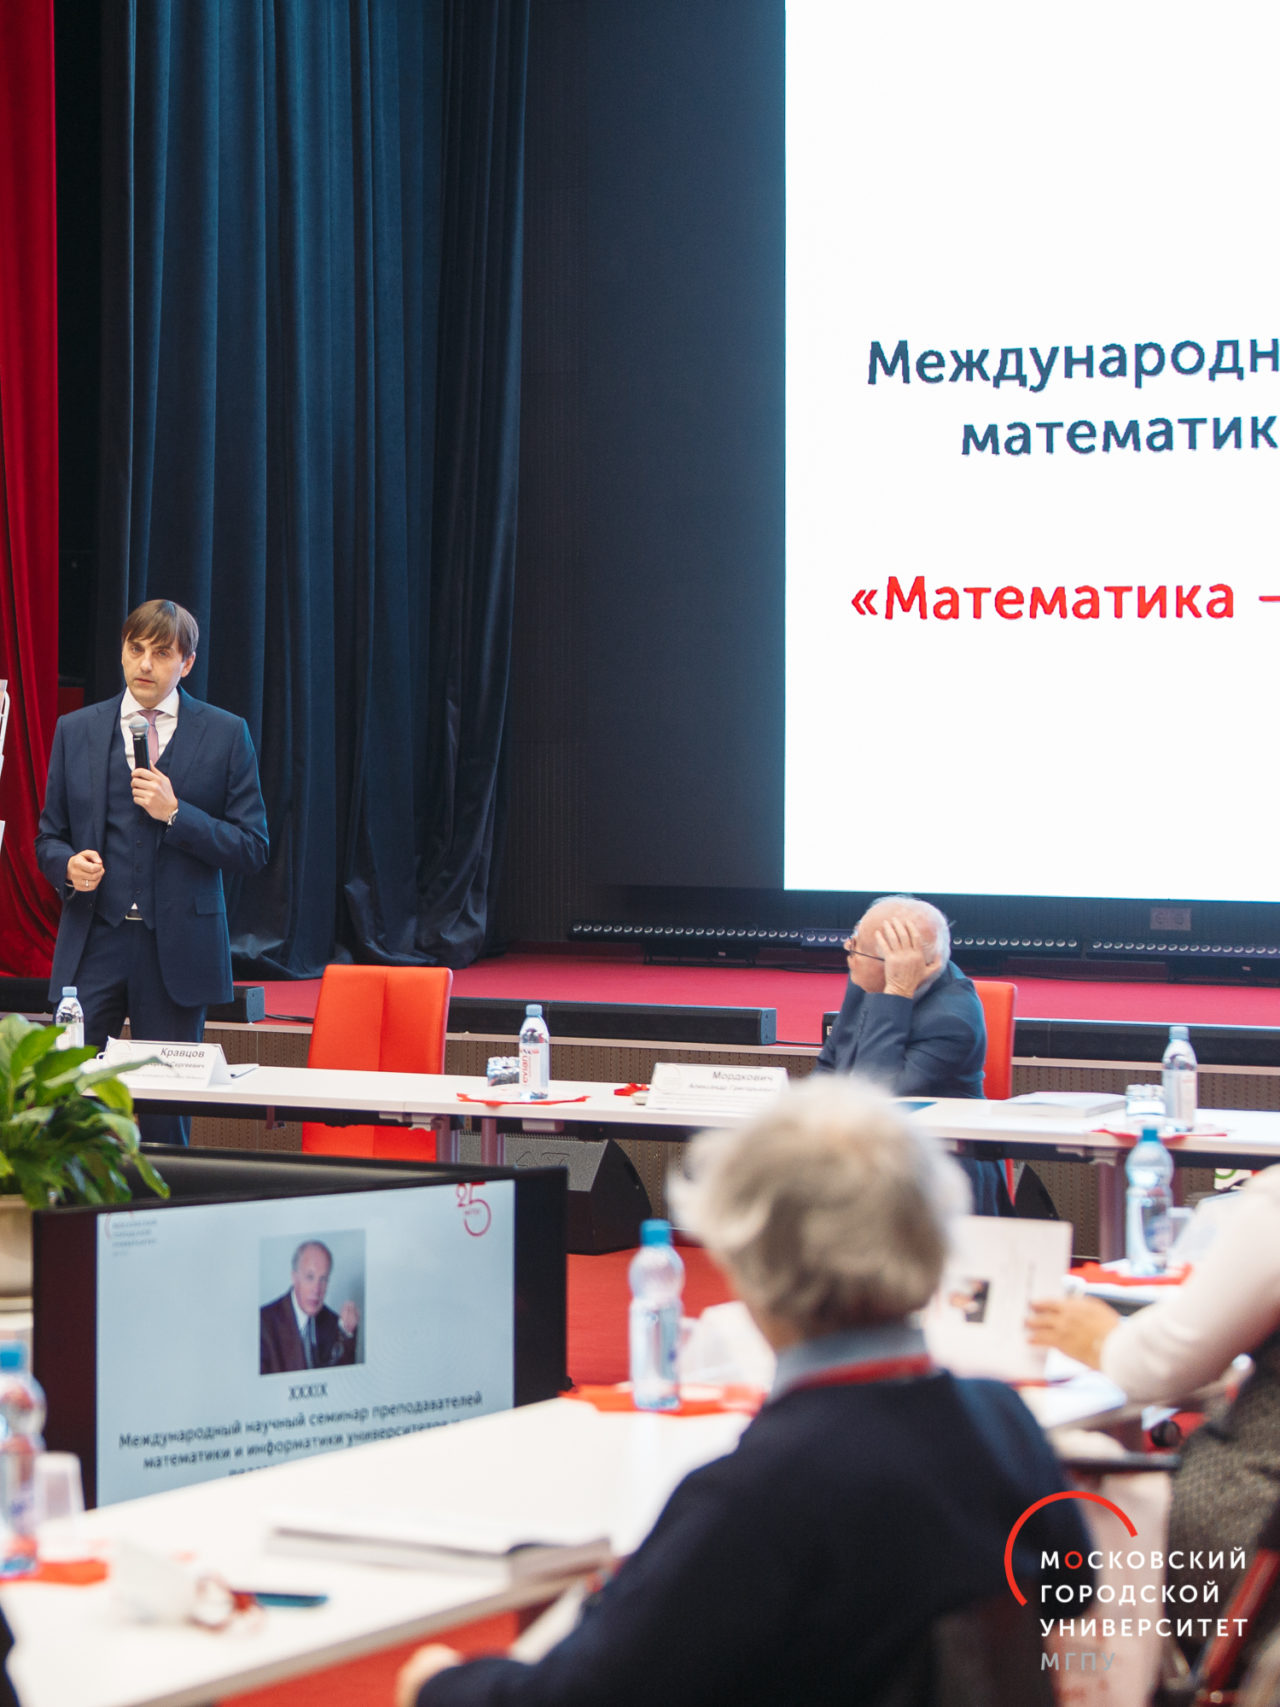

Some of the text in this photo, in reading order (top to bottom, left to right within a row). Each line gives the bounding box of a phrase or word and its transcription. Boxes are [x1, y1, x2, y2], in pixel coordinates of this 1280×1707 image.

[867, 339, 1280, 393] Международн
[962, 415, 1279, 456] математик
[851, 575, 1234, 621] «Математика
[160, 1047, 205, 1059] Кравцов
[712, 1071, 773, 1082] Мордкович
[119, 1389, 483, 1449] Международный научный семинар преподавателей
[143, 1447, 231, 1471] математики
[246, 1433, 344, 1459] информатики
